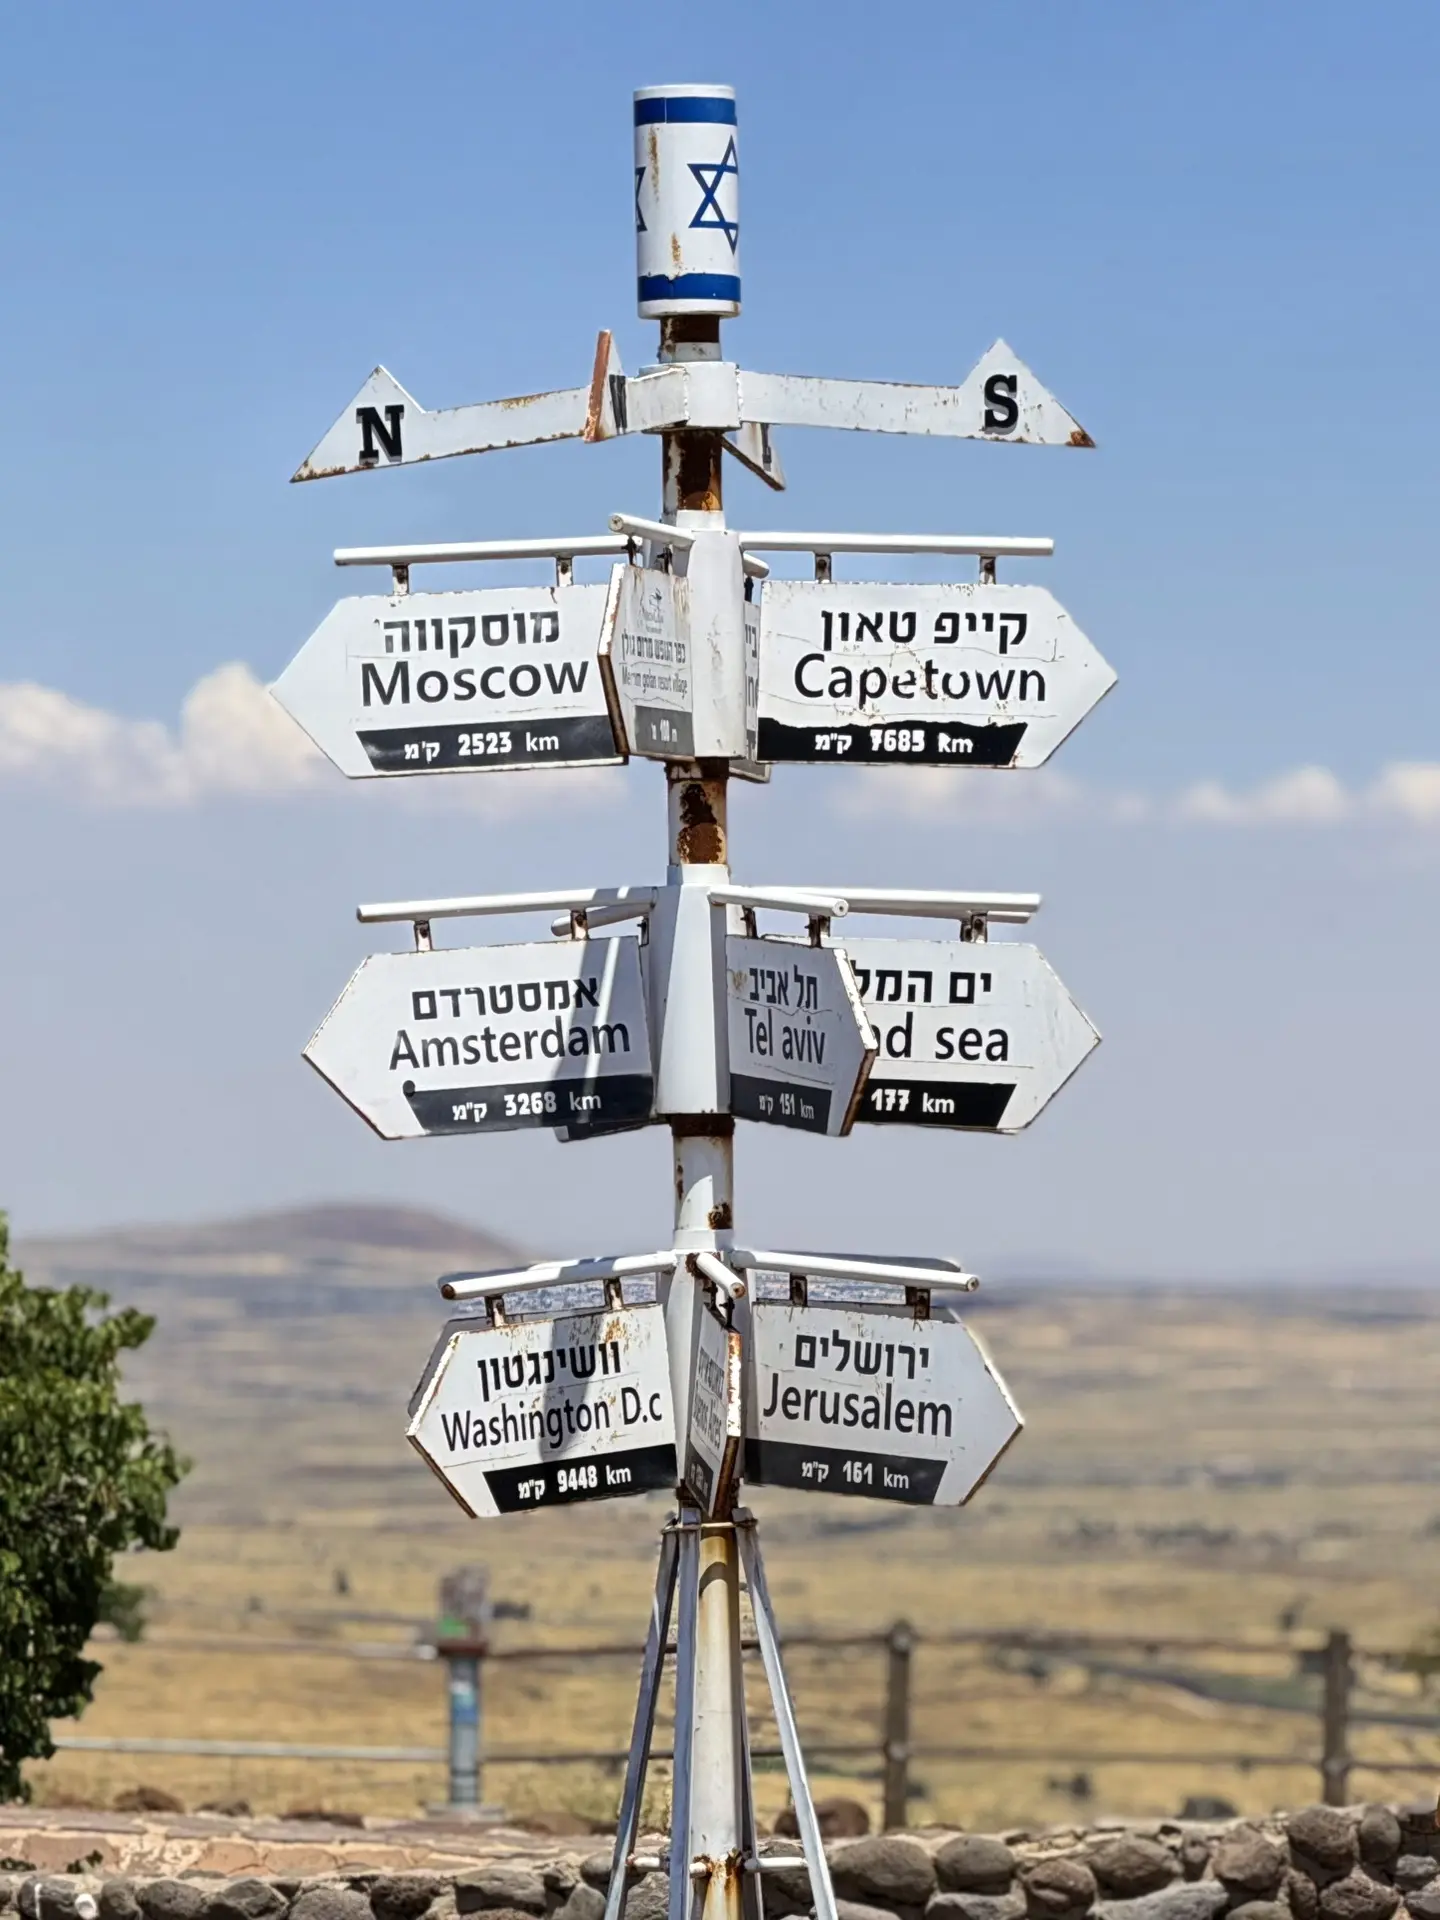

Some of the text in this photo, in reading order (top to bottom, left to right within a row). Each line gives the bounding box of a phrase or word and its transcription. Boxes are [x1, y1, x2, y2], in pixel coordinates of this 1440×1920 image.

[984, 374, 1018, 432] S
[356, 404, 404, 463] N
[383, 610, 560, 658] מוסקווה
[820, 610, 1028, 654] קייפ טאון
[361, 660, 588, 706] Moscow
[794, 653, 1045, 708] Capetown
[458, 731, 512, 756] 2523
[526, 732, 559, 752] km
[412, 977, 600, 1020] אמסטרדם
[749, 964, 818, 1010] תל אביב
[850, 959, 991, 1004] ים המל
[389, 1015, 630, 1070] Amsterdam
[744, 1008, 826, 1064] Tel aviv
[935, 1027, 1009, 1061] sea
[504, 1091, 557, 1116] 3268
[569, 1092, 601, 1111] km
[780, 1092, 795, 1115] 151
[800, 1098, 814, 1119] km
[870, 1089, 955, 1114] 177 km
[477, 1341, 621, 1402] וושינגטון
[794, 1329, 930, 1380] ירושלים
[441, 1397, 611, 1452] Washington
[622, 1386, 663, 1426] D.c
[762, 1372, 953, 1438] Jerusalem
[557, 1465, 598, 1493] 9448
[605, 1464, 632, 1486] km
[843, 1460, 873, 1485] 161
[883, 1466, 909, 1489] km
